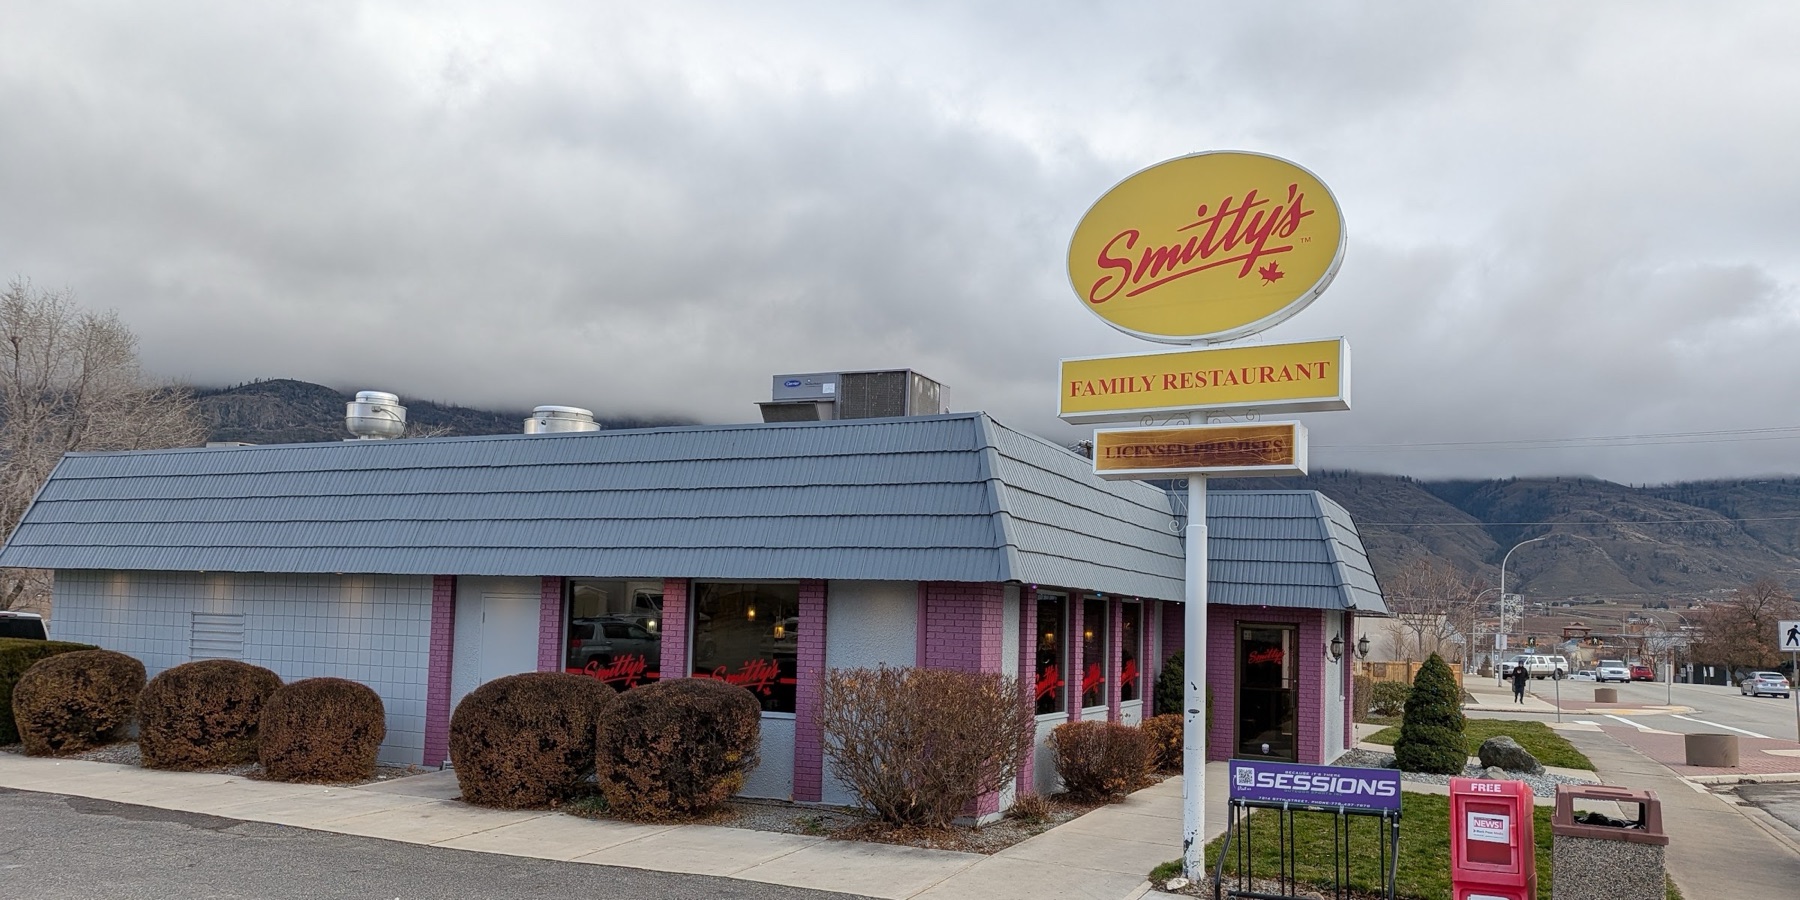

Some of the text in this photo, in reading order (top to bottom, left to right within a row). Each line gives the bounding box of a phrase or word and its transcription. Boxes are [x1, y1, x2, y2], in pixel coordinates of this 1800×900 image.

[1089, 183, 1314, 304] Smitty's
[1300, 236, 1312, 244] TM
[1069, 361, 1331, 398] FAMILY RESTAURANT
[1105, 439, 1283, 459] LICENSED PREMISES
[1256, 772, 1396, 797] SESSIONS
[1471, 783, 1501, 792] FREE
